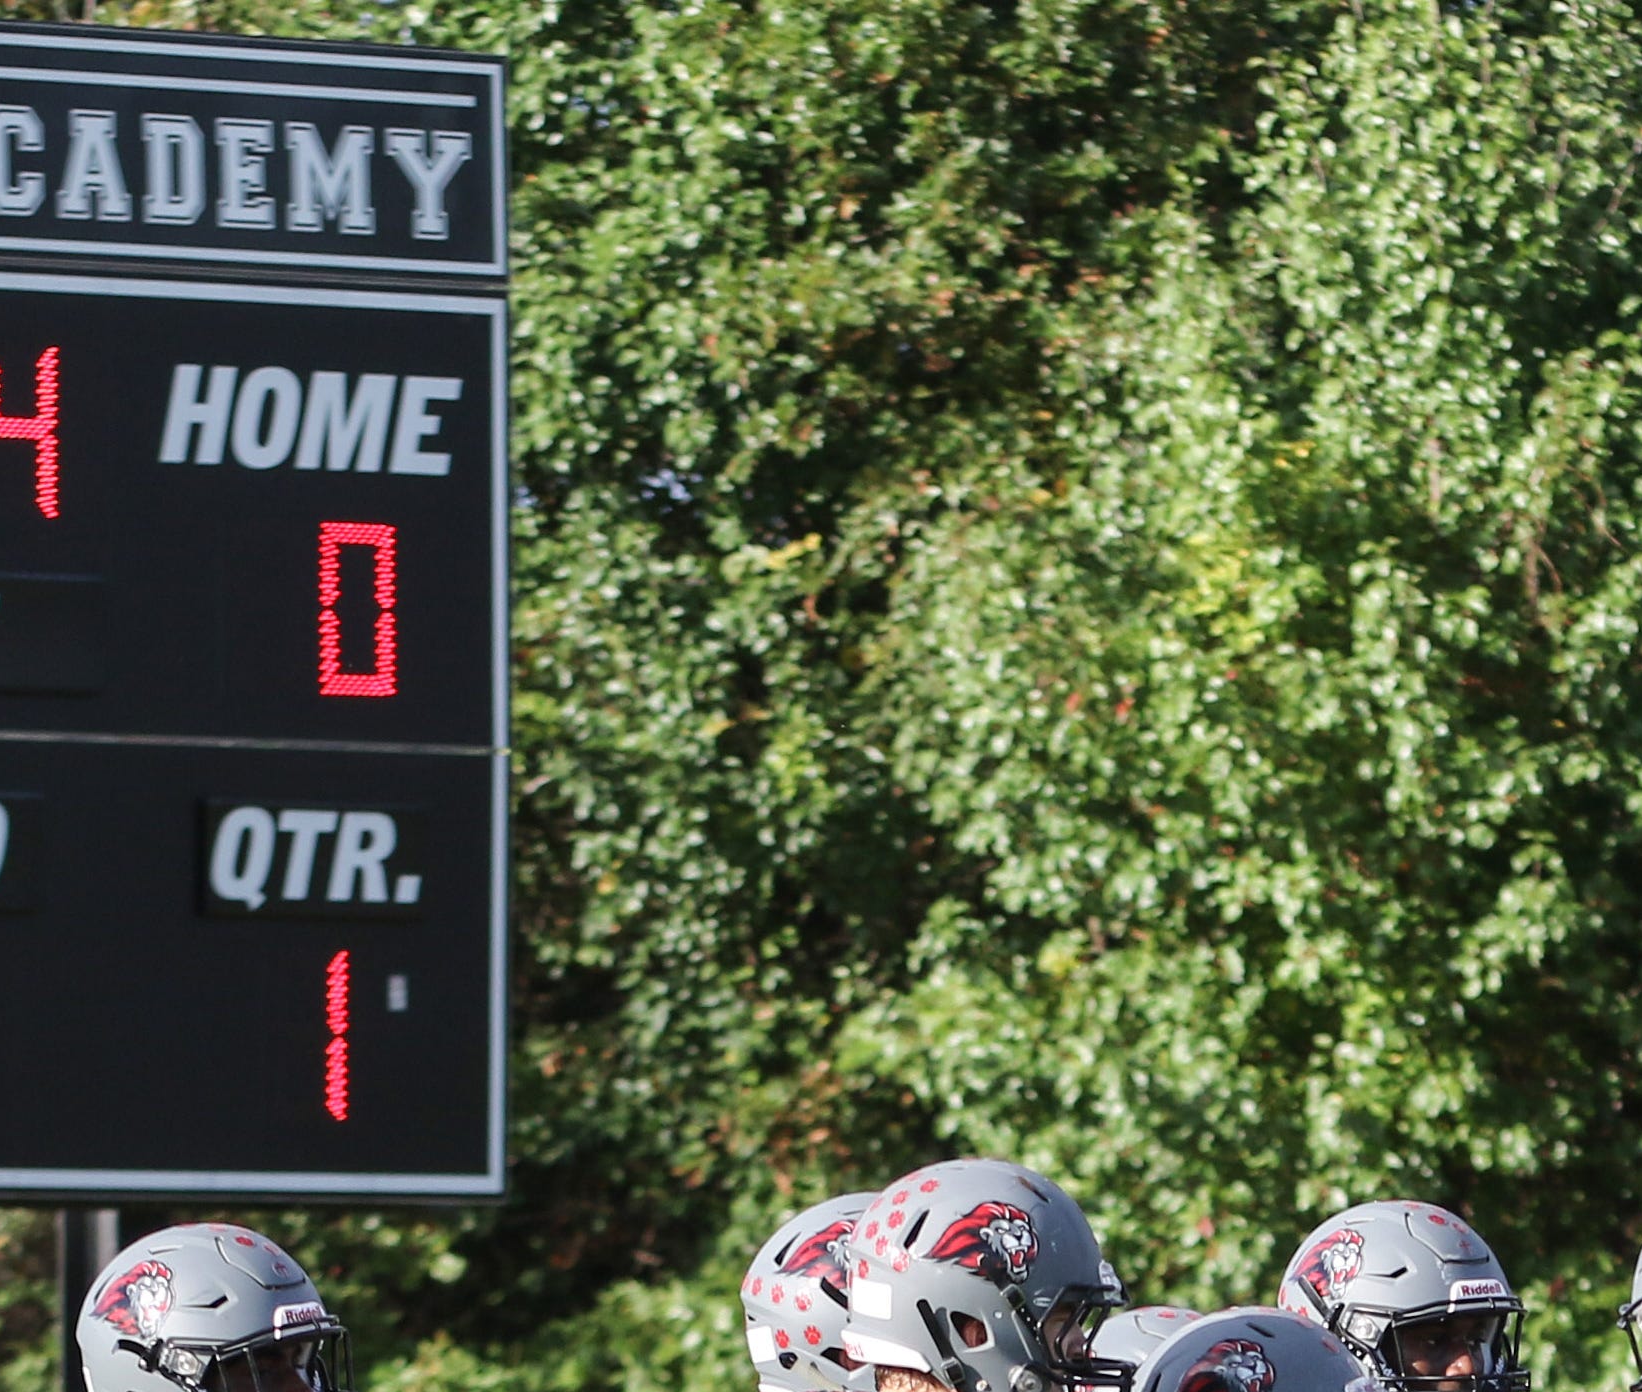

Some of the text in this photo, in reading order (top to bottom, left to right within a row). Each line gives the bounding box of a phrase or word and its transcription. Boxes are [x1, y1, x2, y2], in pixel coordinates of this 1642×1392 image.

[159, 363, 463, 476] HOME
[316, 519, 400, 699] 0
[210, 806, 421, 910] QTR.
[323, 948, 352, 1122] 1
